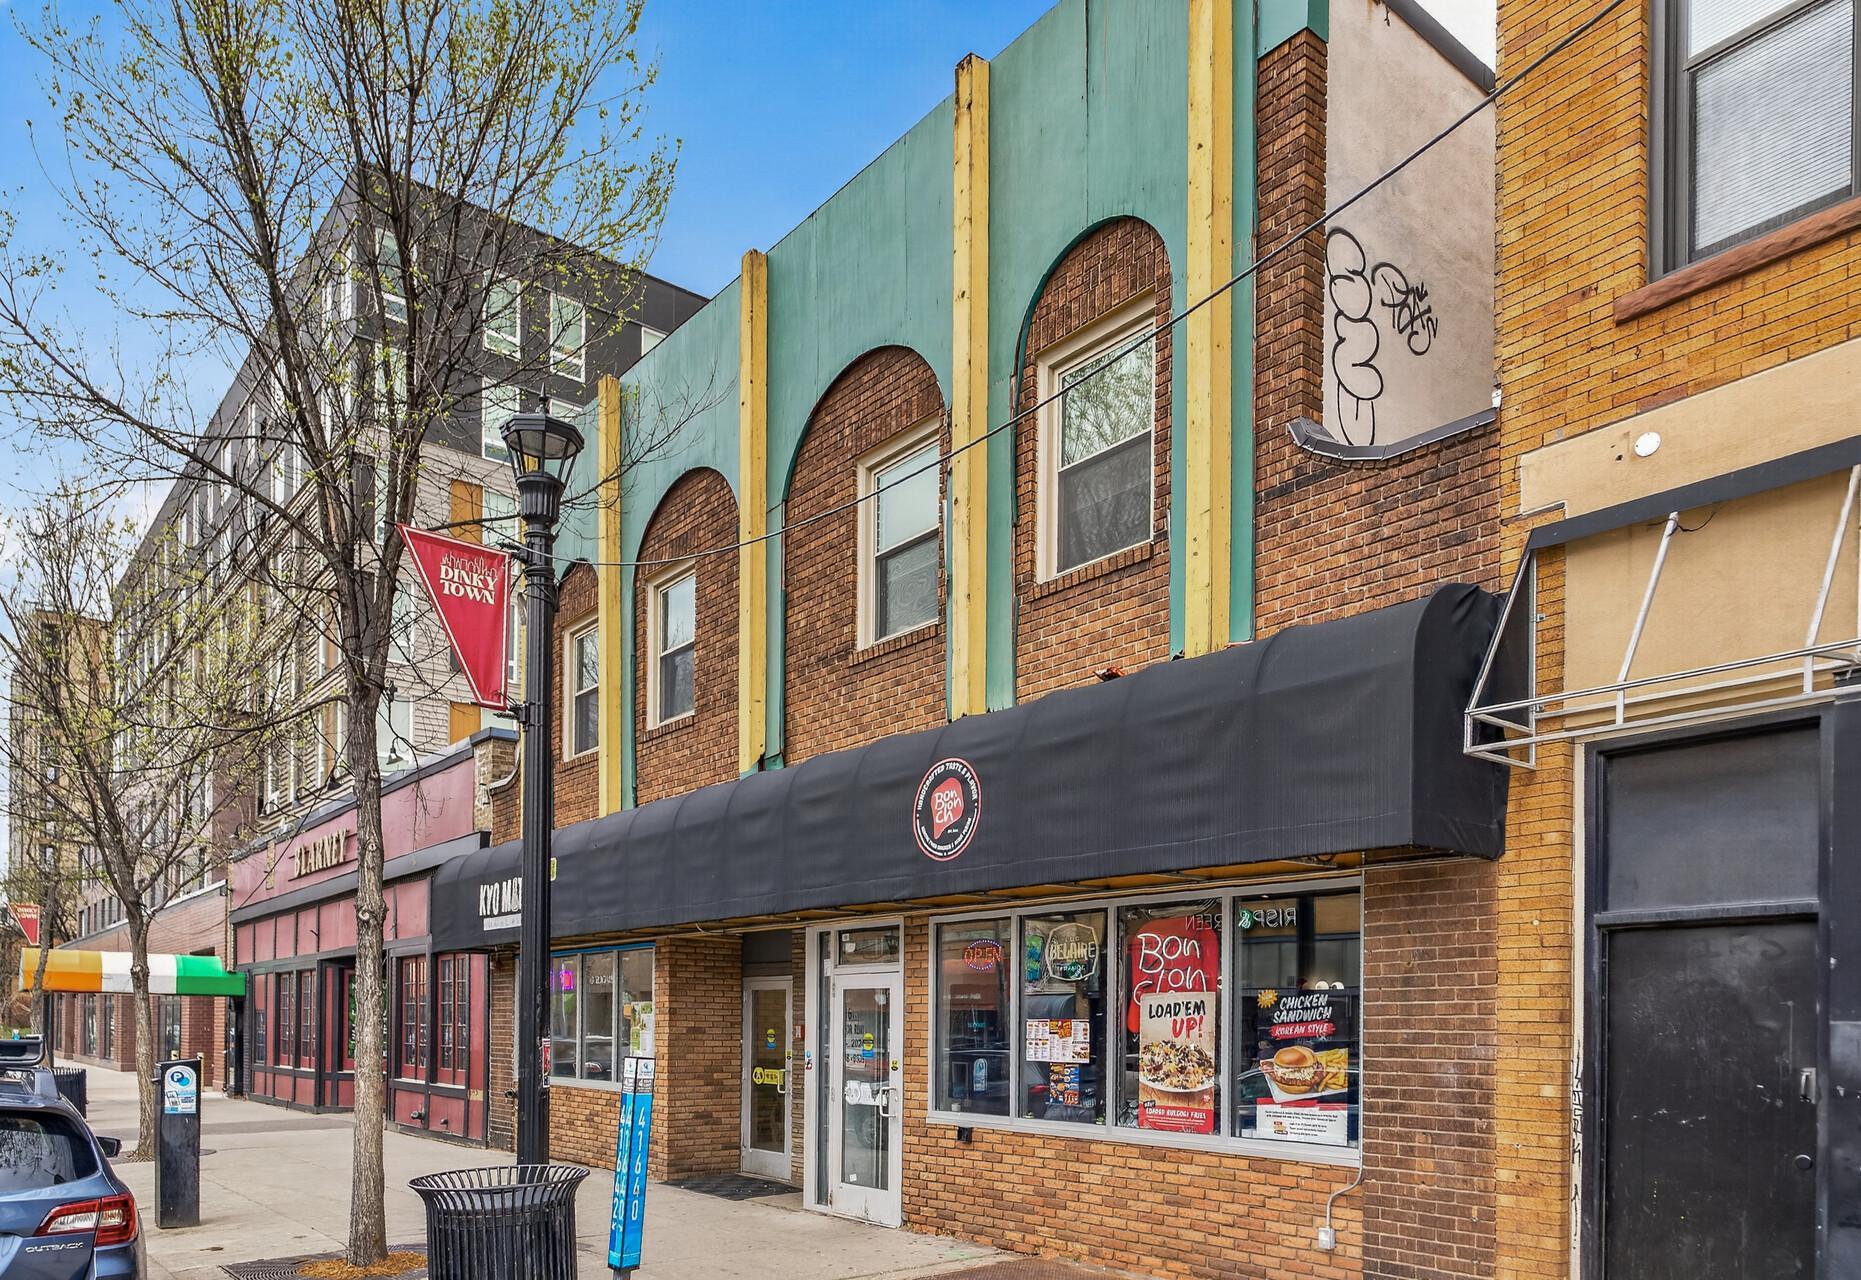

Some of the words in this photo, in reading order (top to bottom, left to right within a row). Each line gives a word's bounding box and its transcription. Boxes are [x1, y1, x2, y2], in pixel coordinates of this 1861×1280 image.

[440, 565, 498, 591] DINKY
[440, 580, 495, 604] TOWN
[294, 829, 348, 878] BLARNEY
[479, 882, 500, 916] KYO
[964, 946, 1001, 964] OPEN
[1050, 941, 1096, 961] BELAIRE
[1137, 933, 1200, 973] Bon
[1148, 1000, 1206, 1019] LOAD'EM
[1280, 993, 1328, 1010] CHICKEN
[1273, 1006, 1332, 1024] SANDWICH
[1171, 1015, 1204, 1039] UP!
[1276, 1026, 1305, 1036] KOREAN
[1307, 1023, 1329, 1034] STYLE
[632, 1106, 645, 1221] 41640
[25, 1241, 84, 1253] OUTBACK
